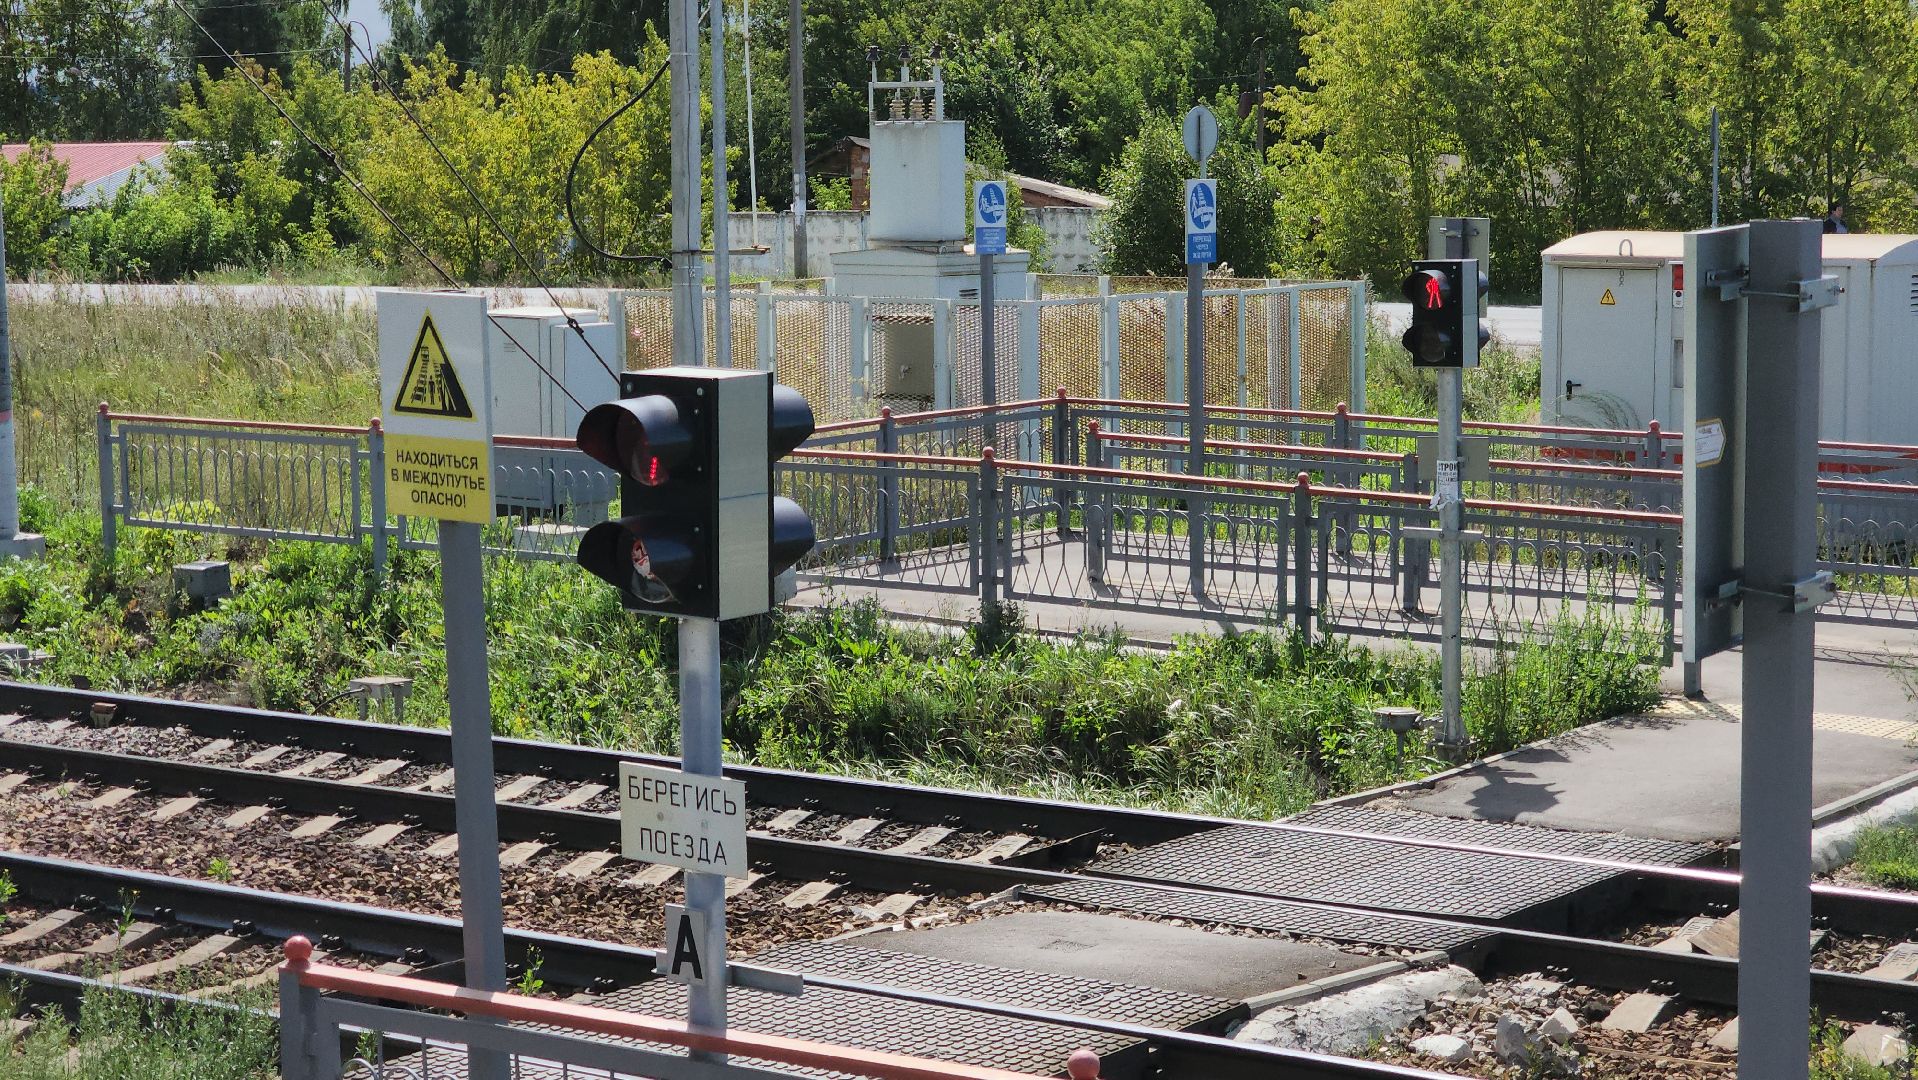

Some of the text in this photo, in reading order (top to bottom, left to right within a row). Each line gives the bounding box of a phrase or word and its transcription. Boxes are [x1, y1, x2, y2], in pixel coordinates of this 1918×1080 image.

[396, 449, 478, 470] НАХОДИТЬСЯ
[391, 468, 485, 490] В МЕЖДУПУТЬЕ
[411, 490, 466, 508] ОПАСНО!
[628, 775, 737, 816] БЕРЕГИСЬ
[640, 827, 727, 866] ПОЕЗДА
[671, 914, 703, 980] А
